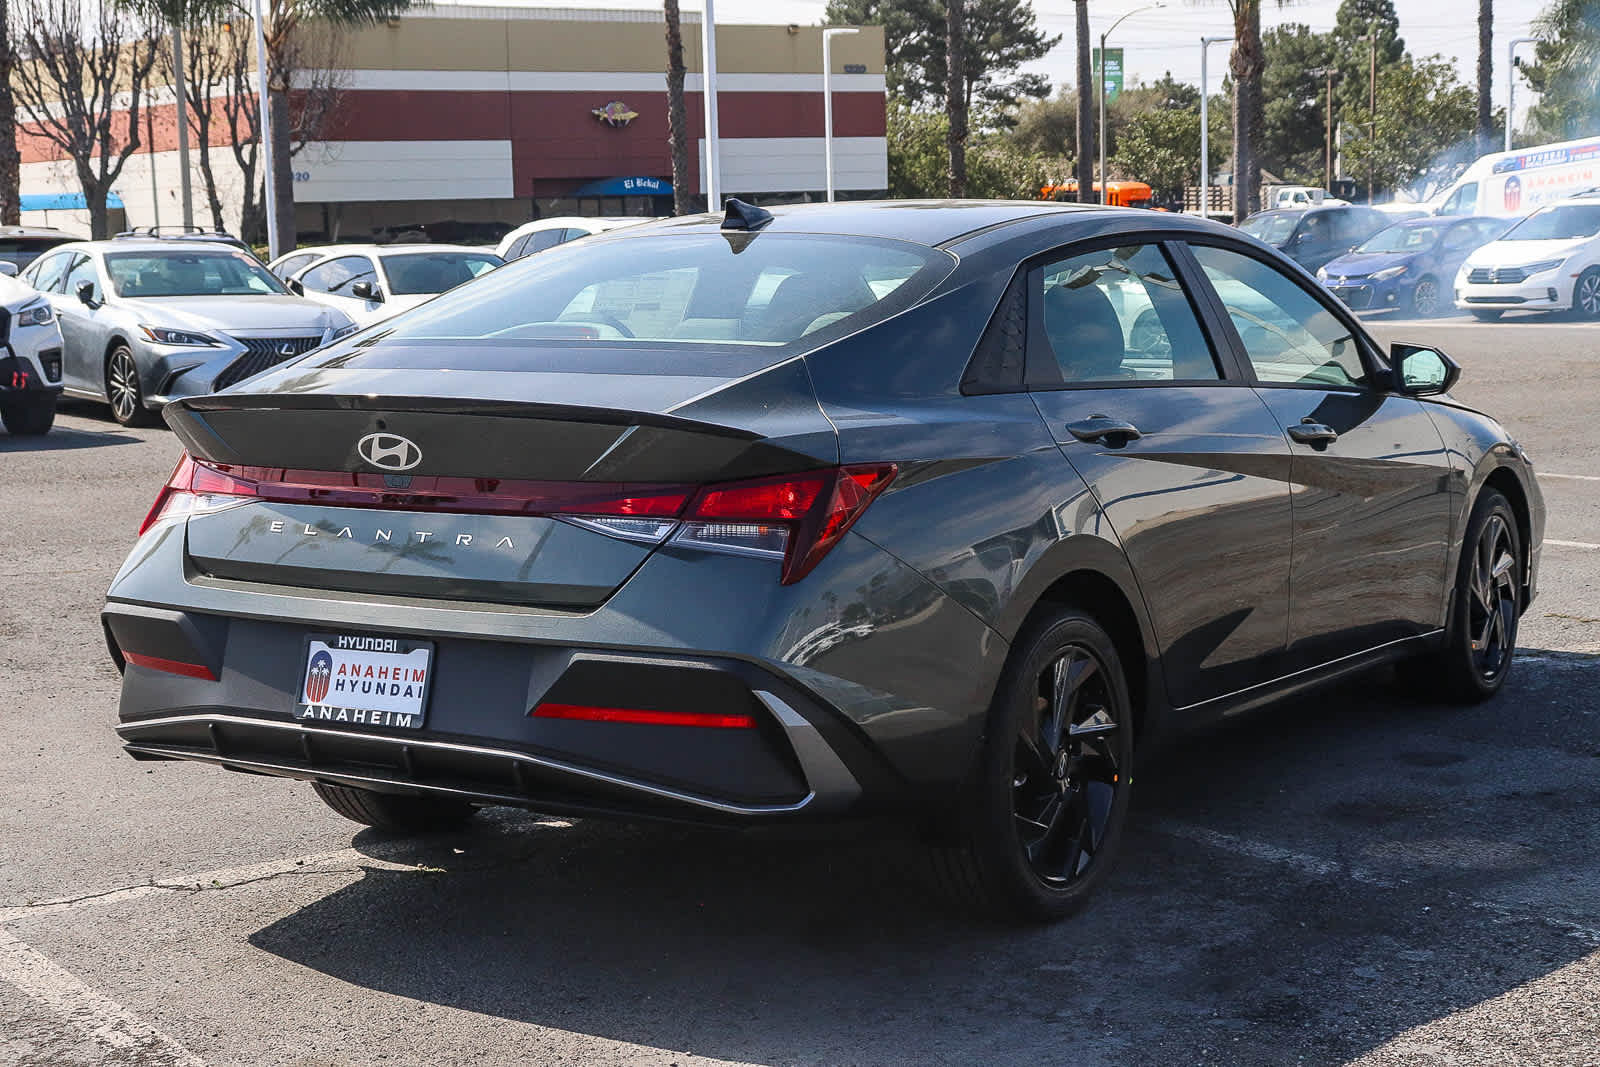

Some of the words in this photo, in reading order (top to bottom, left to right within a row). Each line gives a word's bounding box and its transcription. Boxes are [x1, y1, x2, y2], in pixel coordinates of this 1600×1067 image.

[270, 521, 515, 549] ELANTRA
[338, 635, 398, 652] HYUNDAI
[337, 663, 425, 683] ANAHEIM
[335, 679, 423, 699] HYUNDAI
[302, 705, 413, 727] ANAHEIM
